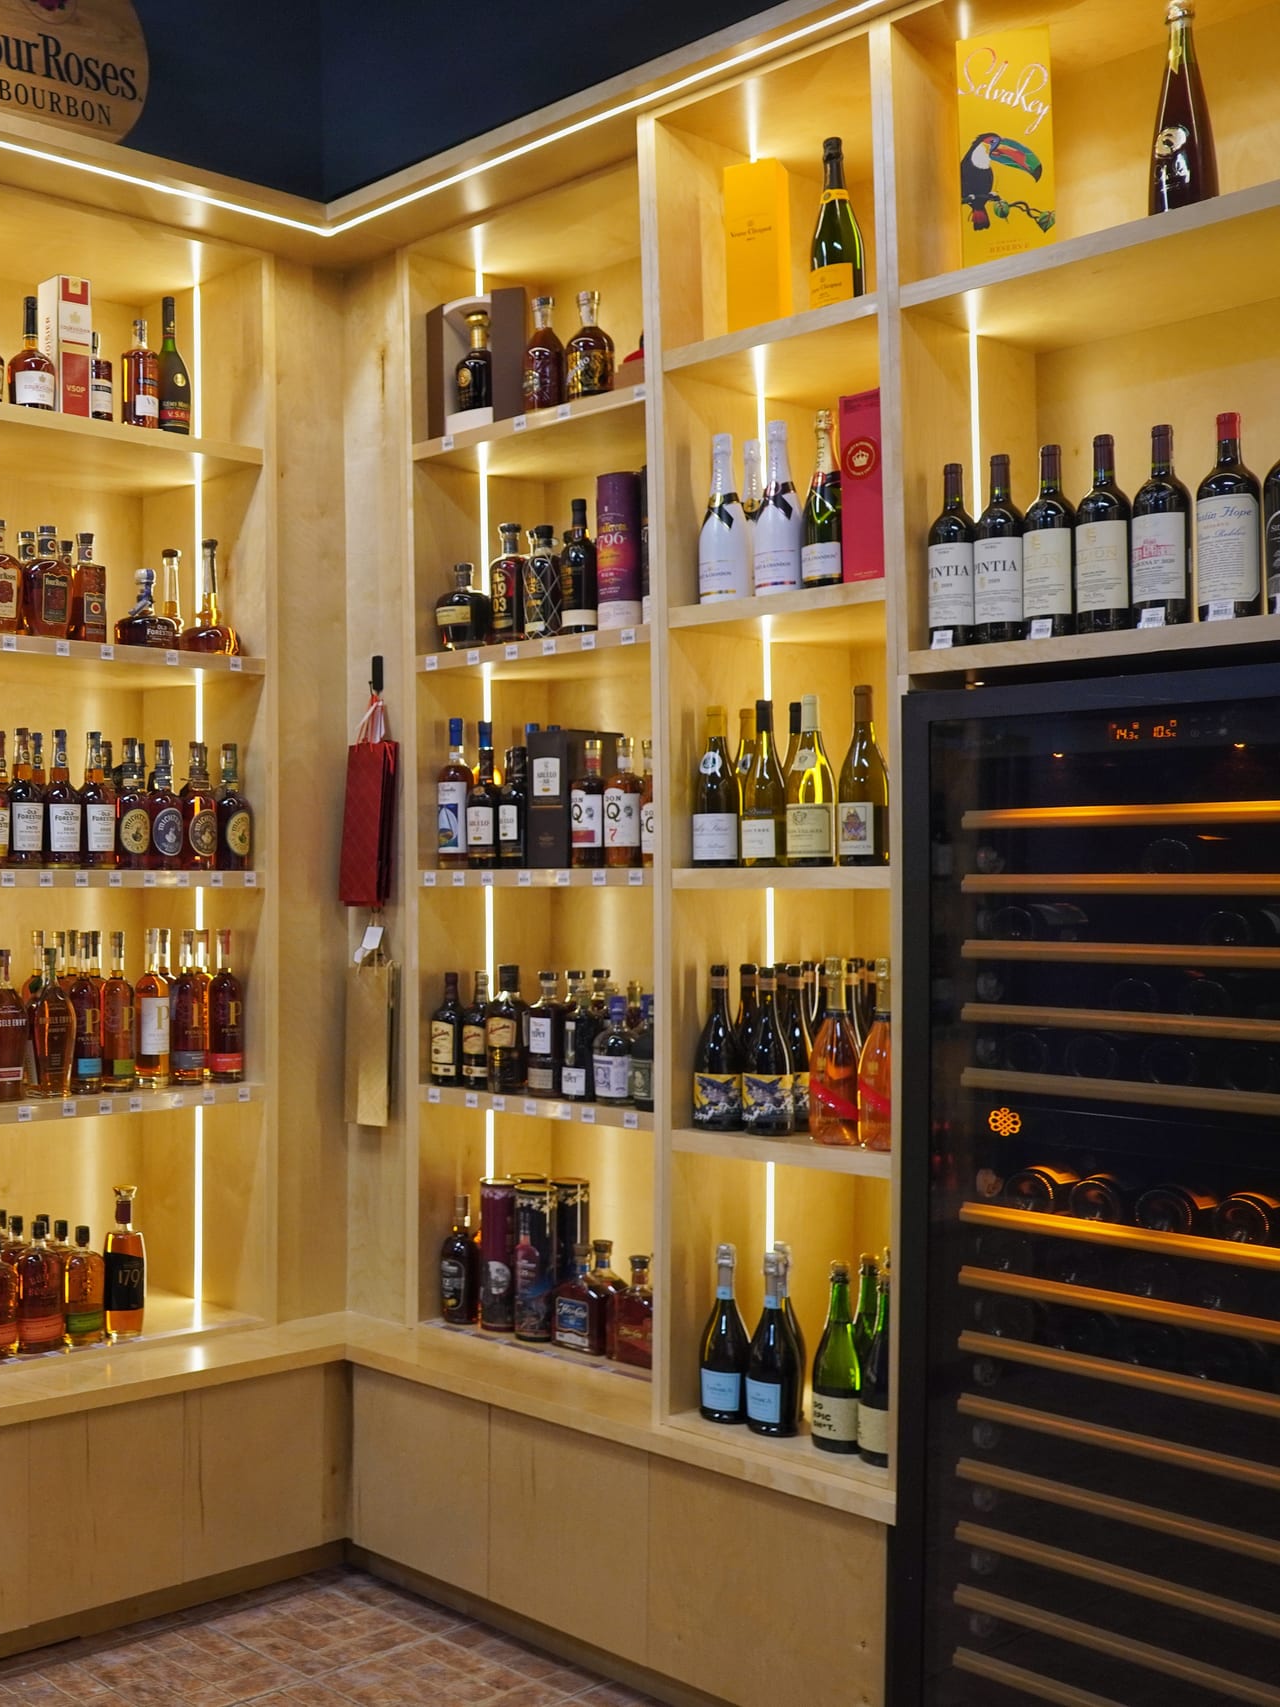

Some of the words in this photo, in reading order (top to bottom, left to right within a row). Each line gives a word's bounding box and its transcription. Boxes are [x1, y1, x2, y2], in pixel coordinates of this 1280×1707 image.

[38, 33, 138, 101] Roses
[66, 384, 87, 393] VSOP
[1222, 505, 1252, 521] Hope
[605, 802, 622, 822] Q
[608, 827, 618, 842] 7
[12, 1018, 27, 1027] ENVY
